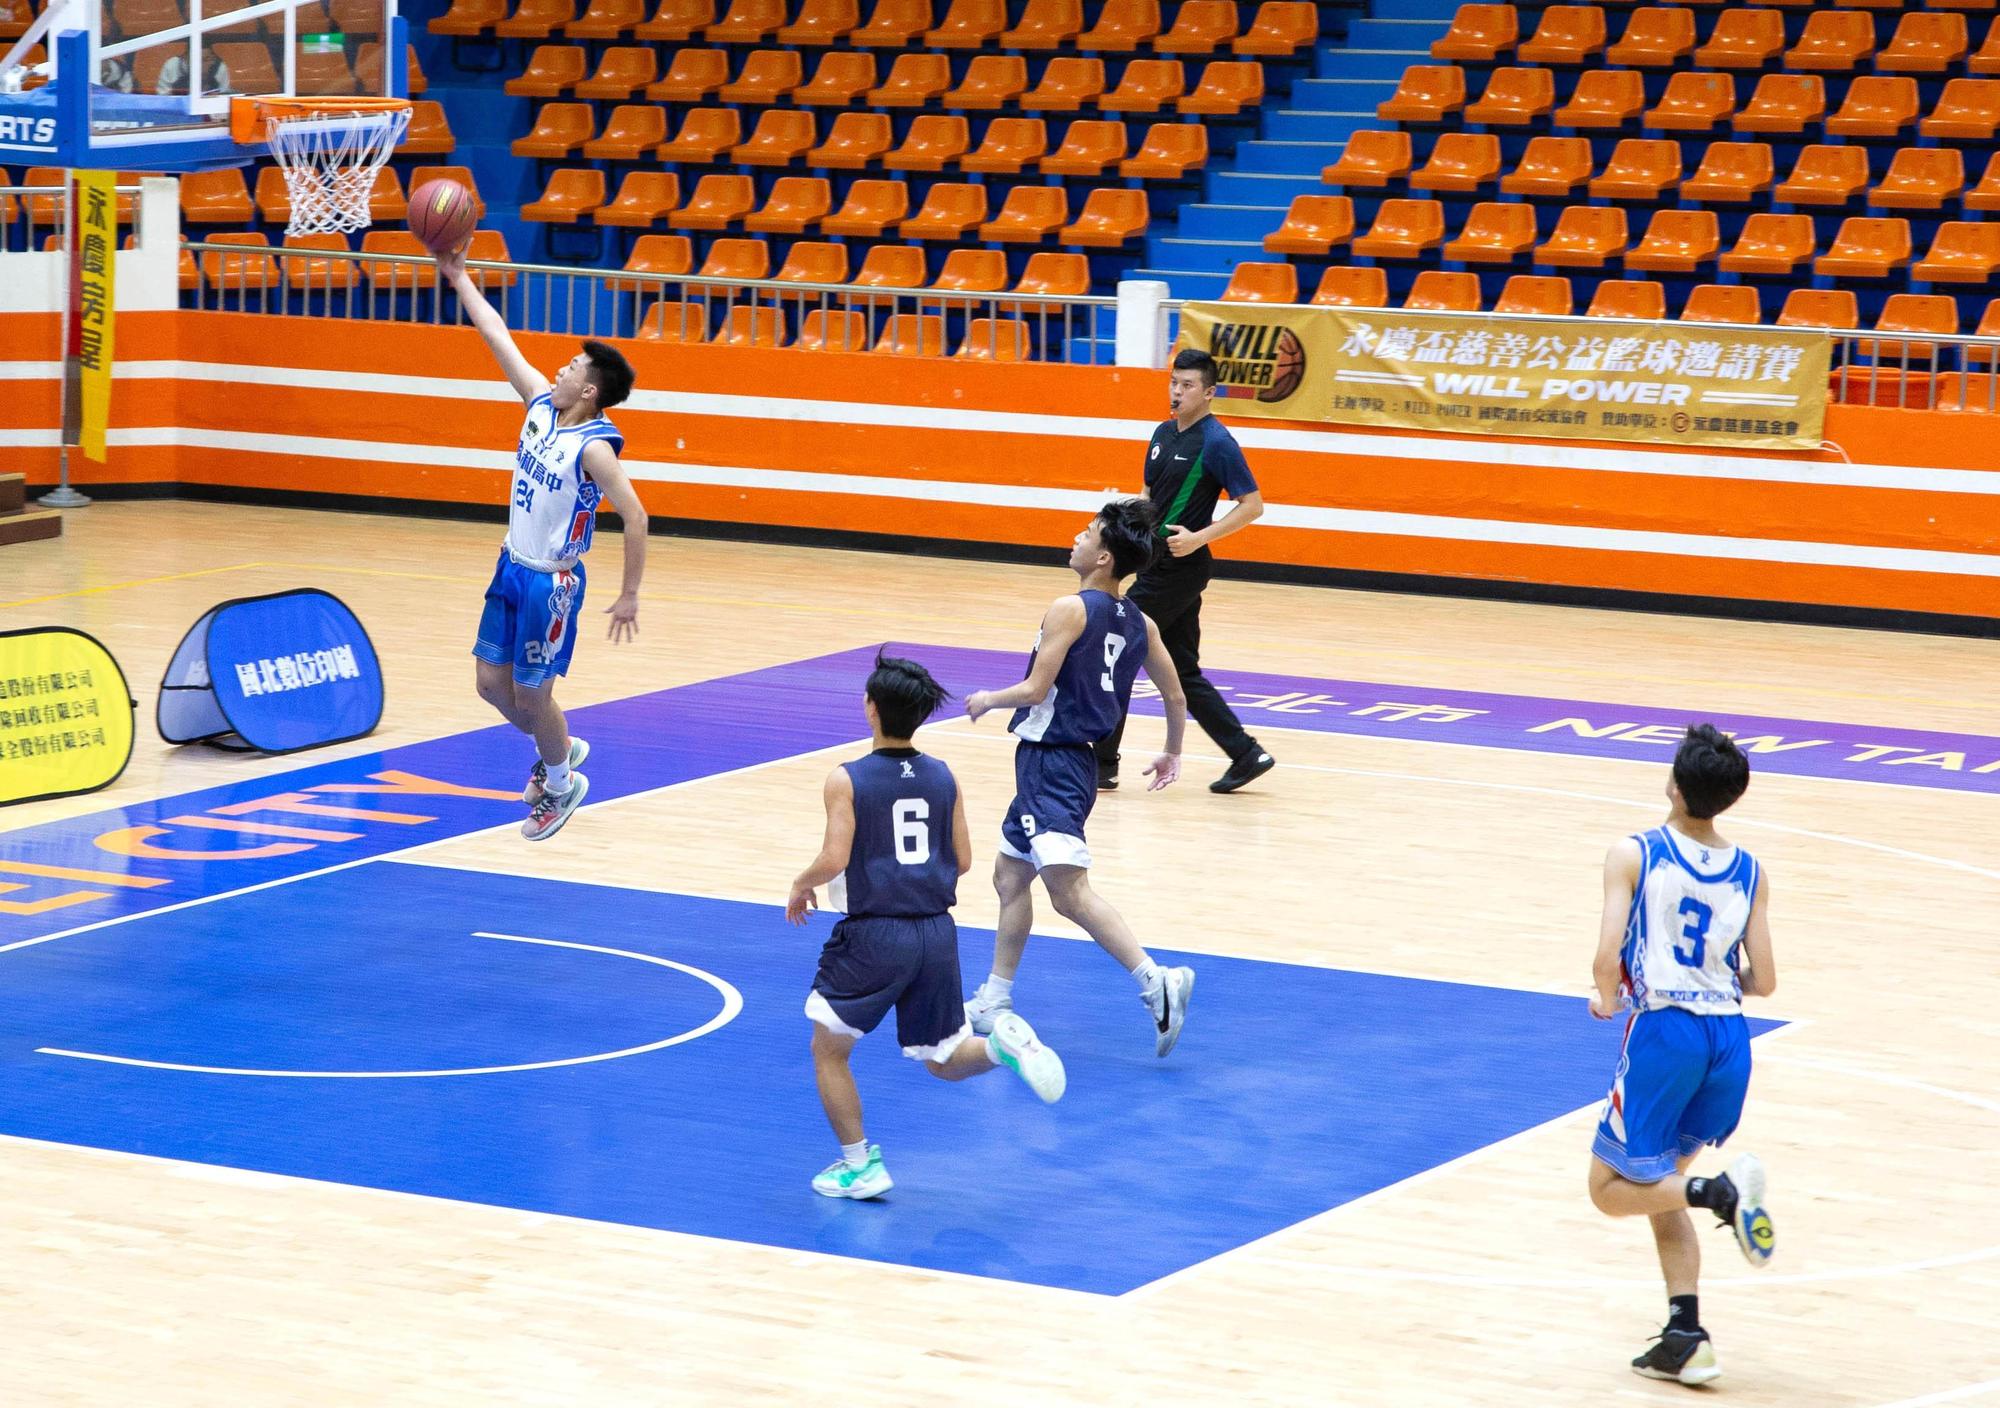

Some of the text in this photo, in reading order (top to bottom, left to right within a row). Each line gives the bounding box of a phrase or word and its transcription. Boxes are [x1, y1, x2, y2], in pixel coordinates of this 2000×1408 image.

[1211, 323, 1282, 360] WILL
[1338, 322, 1804, 383] 永慶盃慈善公益籃球邀請賽
[1216, 361, 1273, 386] OWER
[1433, 373, 1692, 406] WILL POWER
[516, 479, 535, 514] 24
[525, 640, 554, 665] 24
[1101, 632, 1126, 692] 9
[93, 769, 525, 860] CITY
[892, 798, 930, 865] 6
[1020, 814, 1036, 837] 9
[1672, 896, 1713, 968] 3
